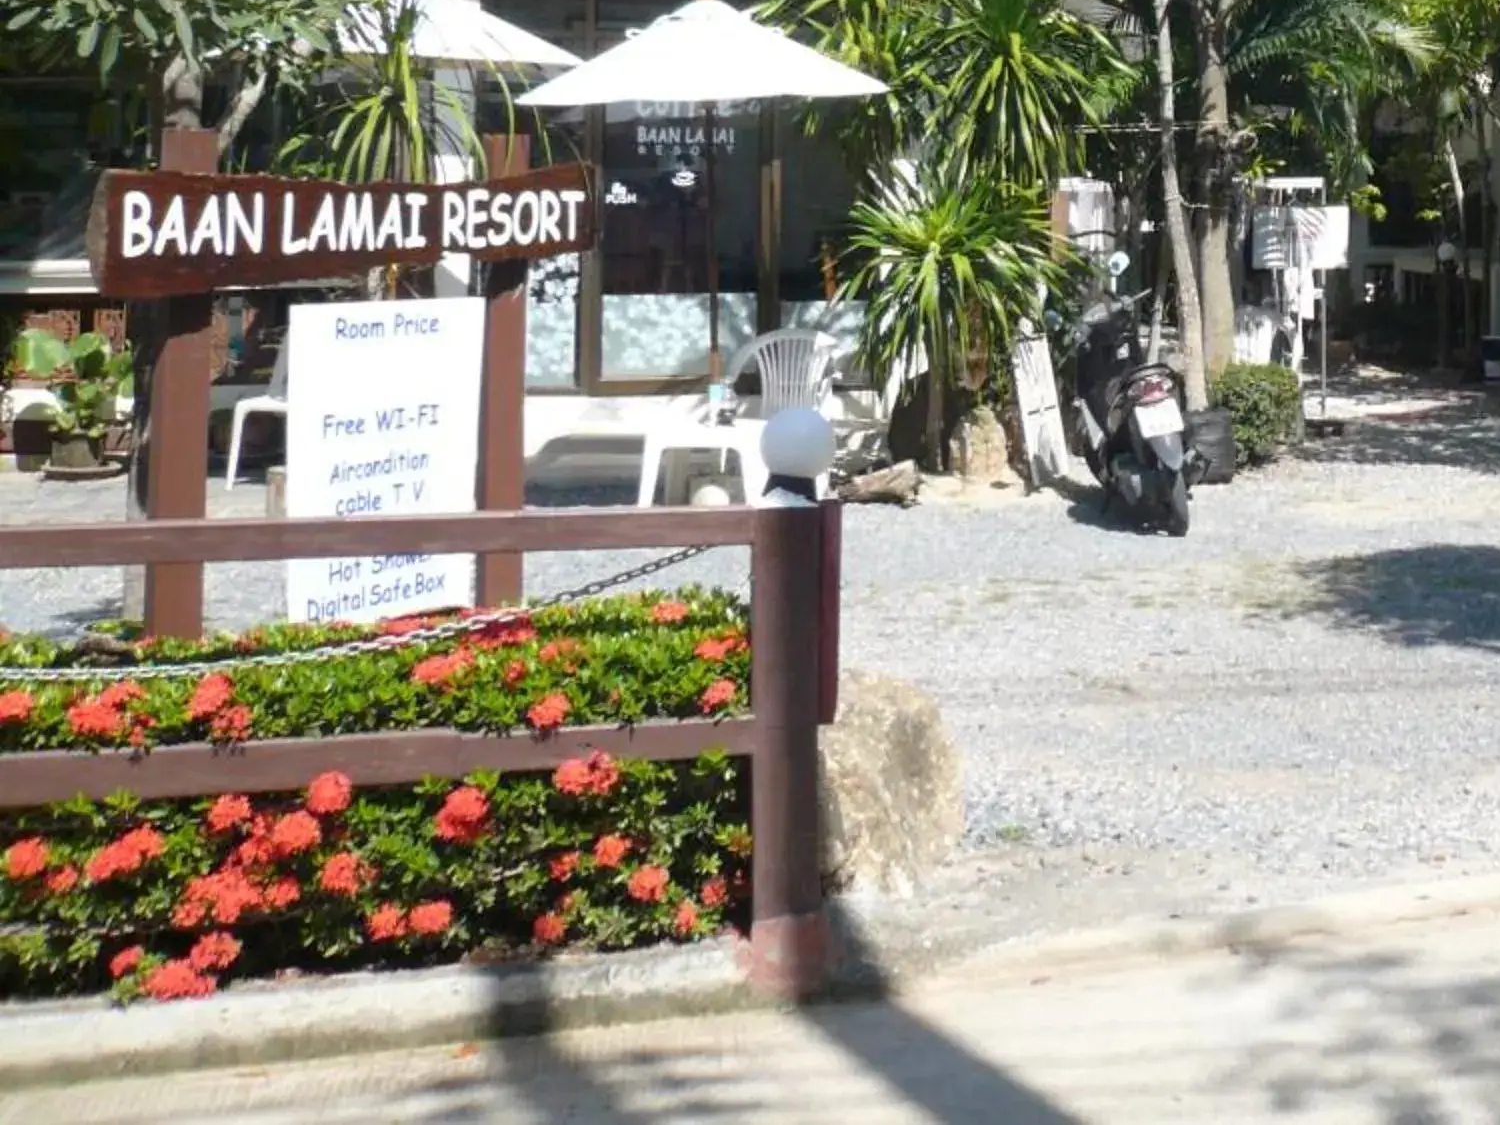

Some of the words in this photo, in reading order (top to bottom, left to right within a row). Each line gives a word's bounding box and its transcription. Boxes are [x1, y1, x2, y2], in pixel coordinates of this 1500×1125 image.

[637, 125, 681, 144] BAAN
[122, 190, 264, 258] BAAN
[282, 192, 427, 253] LAMAI
[441, 189, 586, 249] RESORT
[335, 317, 385, 339] Room
[393, 313, 440, 336] Price
[323, 414, 365, 439] Free
[375, 404, 440, 432] WI-FI
[330, 448, 430, 485] Aircondition
[335, 487, 382, 516] cable
[328, 559, 362, 585] Hot
[371, 554, 432, 574] Show
